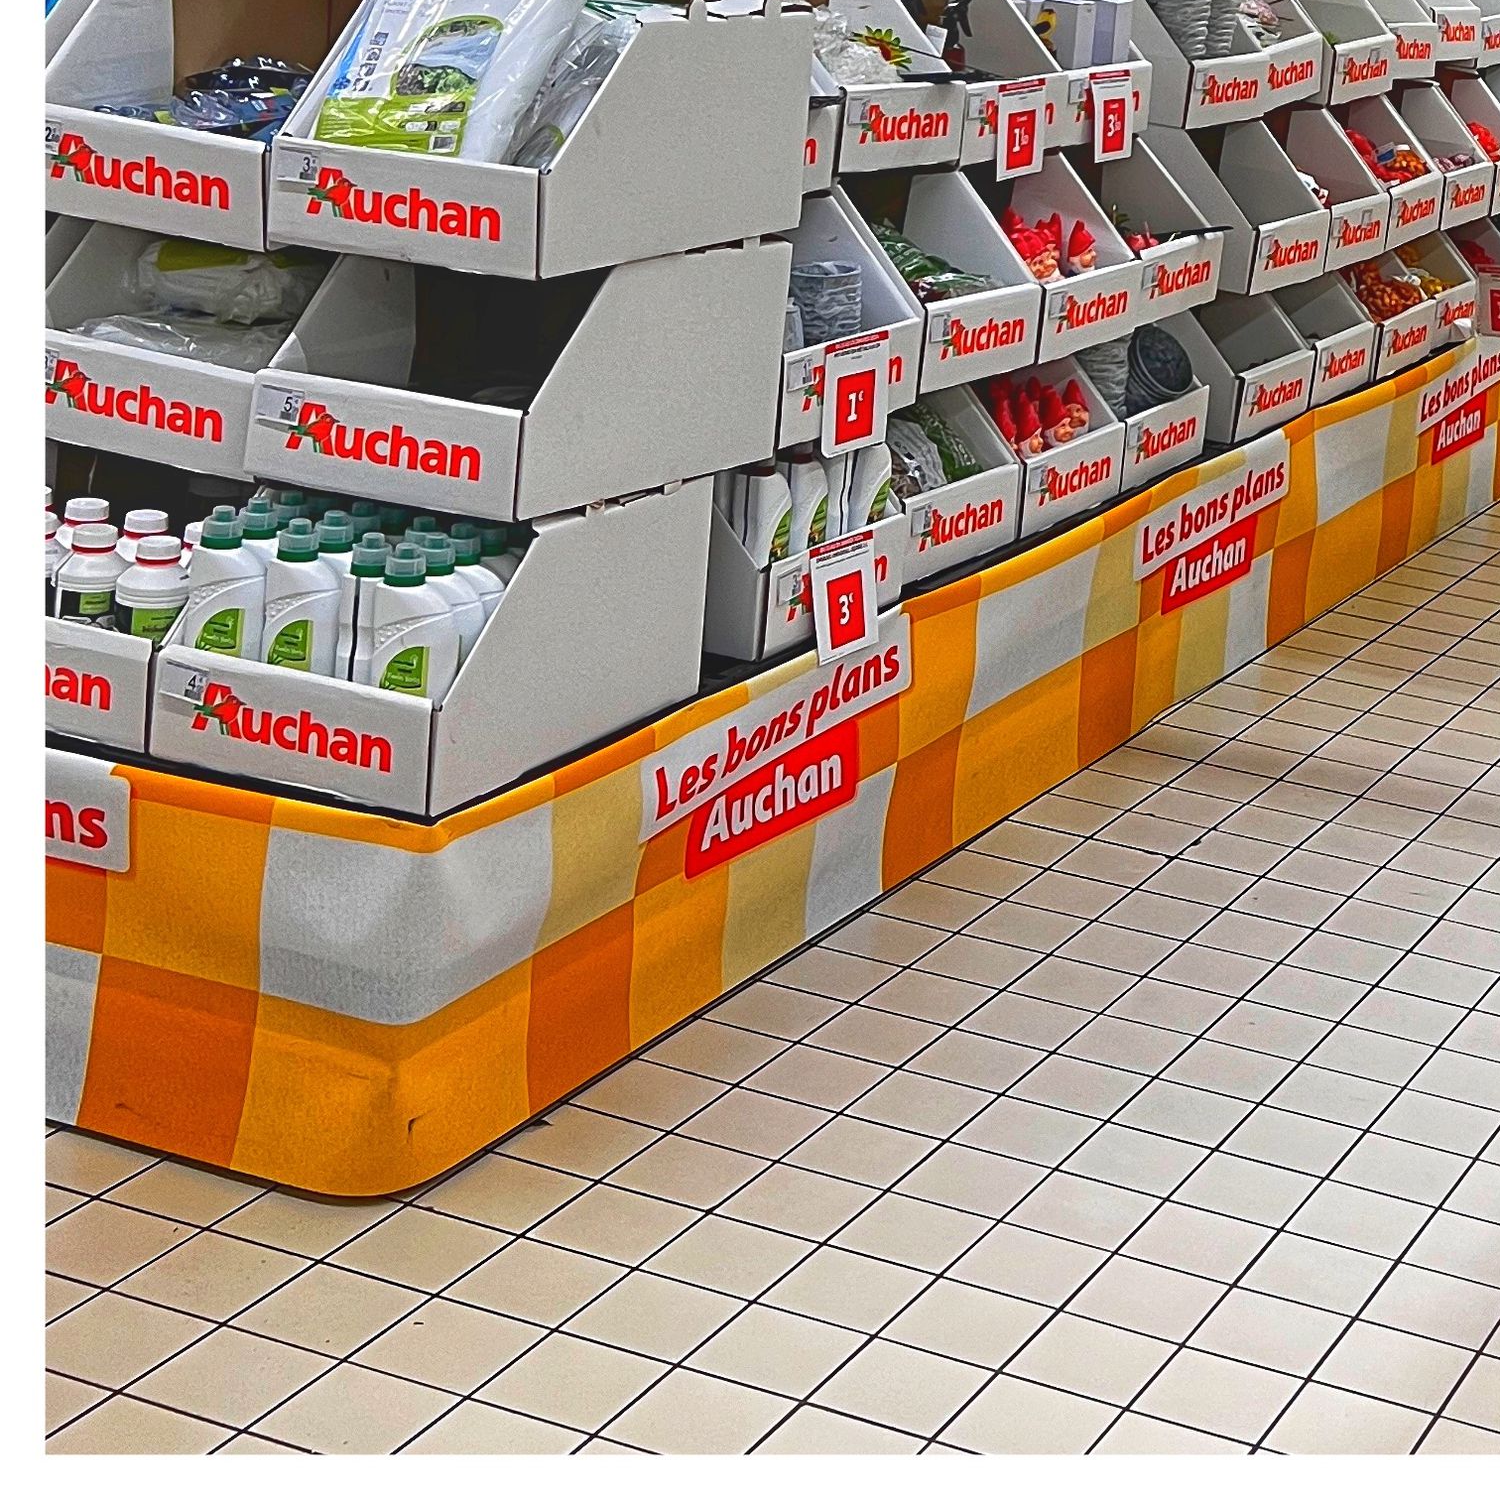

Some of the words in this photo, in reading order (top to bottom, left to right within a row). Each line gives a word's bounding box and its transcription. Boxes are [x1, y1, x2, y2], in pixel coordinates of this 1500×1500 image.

[1201, 78, 1257, 106] Auchan
[859, 105, 949, 144] Auchan
[51, 134, 230, 210] Auchan
[307, 168, 501, 241] Auchan
[1149, 263, 1211, 300] Auchan
[1265, 242, 1317, 270] Auchan
[1057, 292, 1128, 333] Auchan
[941, 319, 1025, 360] Auchan
[45, 360, 222, 443] Auchan
[1248, 381, 1302, 415] Auchan
[1420, 390, 1444, 423] Les
[1445, 371, 1472, 408] bons
[284, 403, 480, 481] Auchan
[1135, 419, 1196, 464] Auchan
[1437, 403, 1482, 450] Auchan
[1039, 458, 1112, 506] Auchan
[919, 500, 1003, 552] Auchan
[1142, 521, 1176, 565] Les
[1179, 492, 1229, 542] bons
[1230, 461, 1285, 523] plans
[1169, 537, 1247, 597] Auchan
[192, 683, 392, 773] Auchan
[655, 753, 717, 821] Les
[721, 707, 802, 779] bons
[804, 644, 900, 739] plans
[700, 752, 842, 853] Auchan
